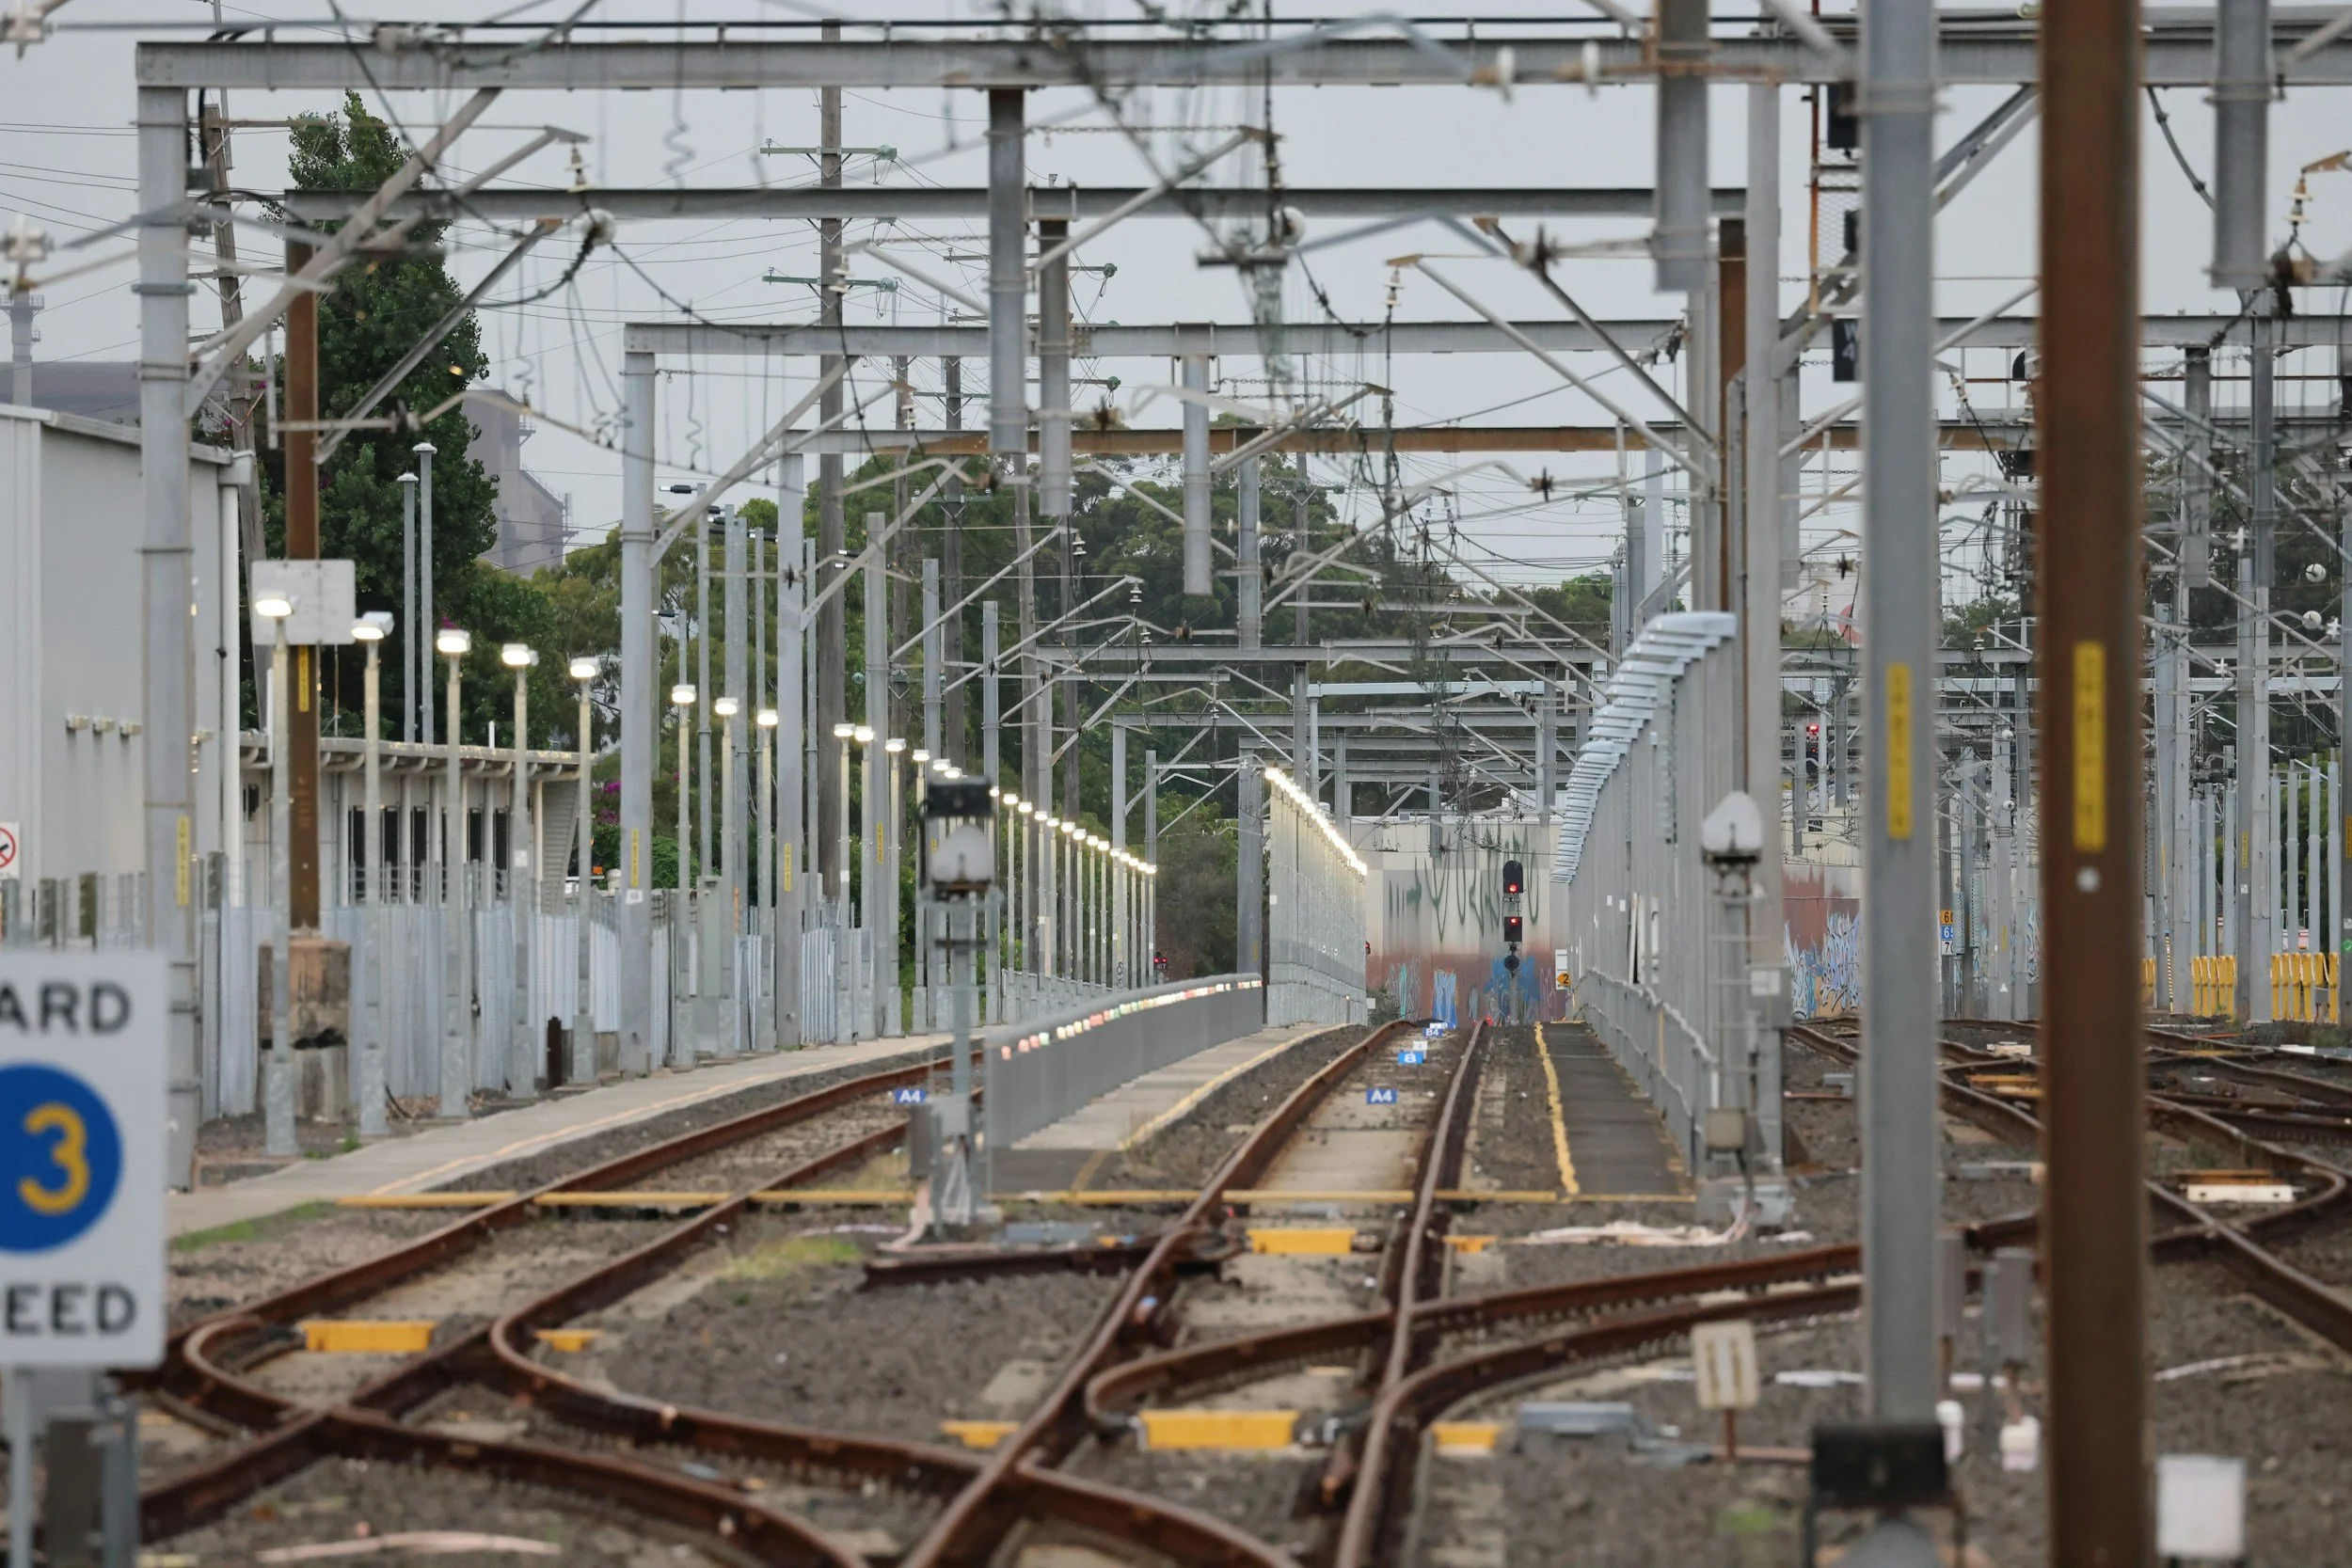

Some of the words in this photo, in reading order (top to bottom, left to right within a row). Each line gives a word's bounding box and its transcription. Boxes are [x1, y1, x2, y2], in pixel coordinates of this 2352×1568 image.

[1563, 974, 1569, 985] 2
[899, 1089, 920, 1102] A4
[1371, 1089, 1392, 1102] A4
[17, 1101, 90, 1215] 3
[4, 1283, 138, 1336] EED
